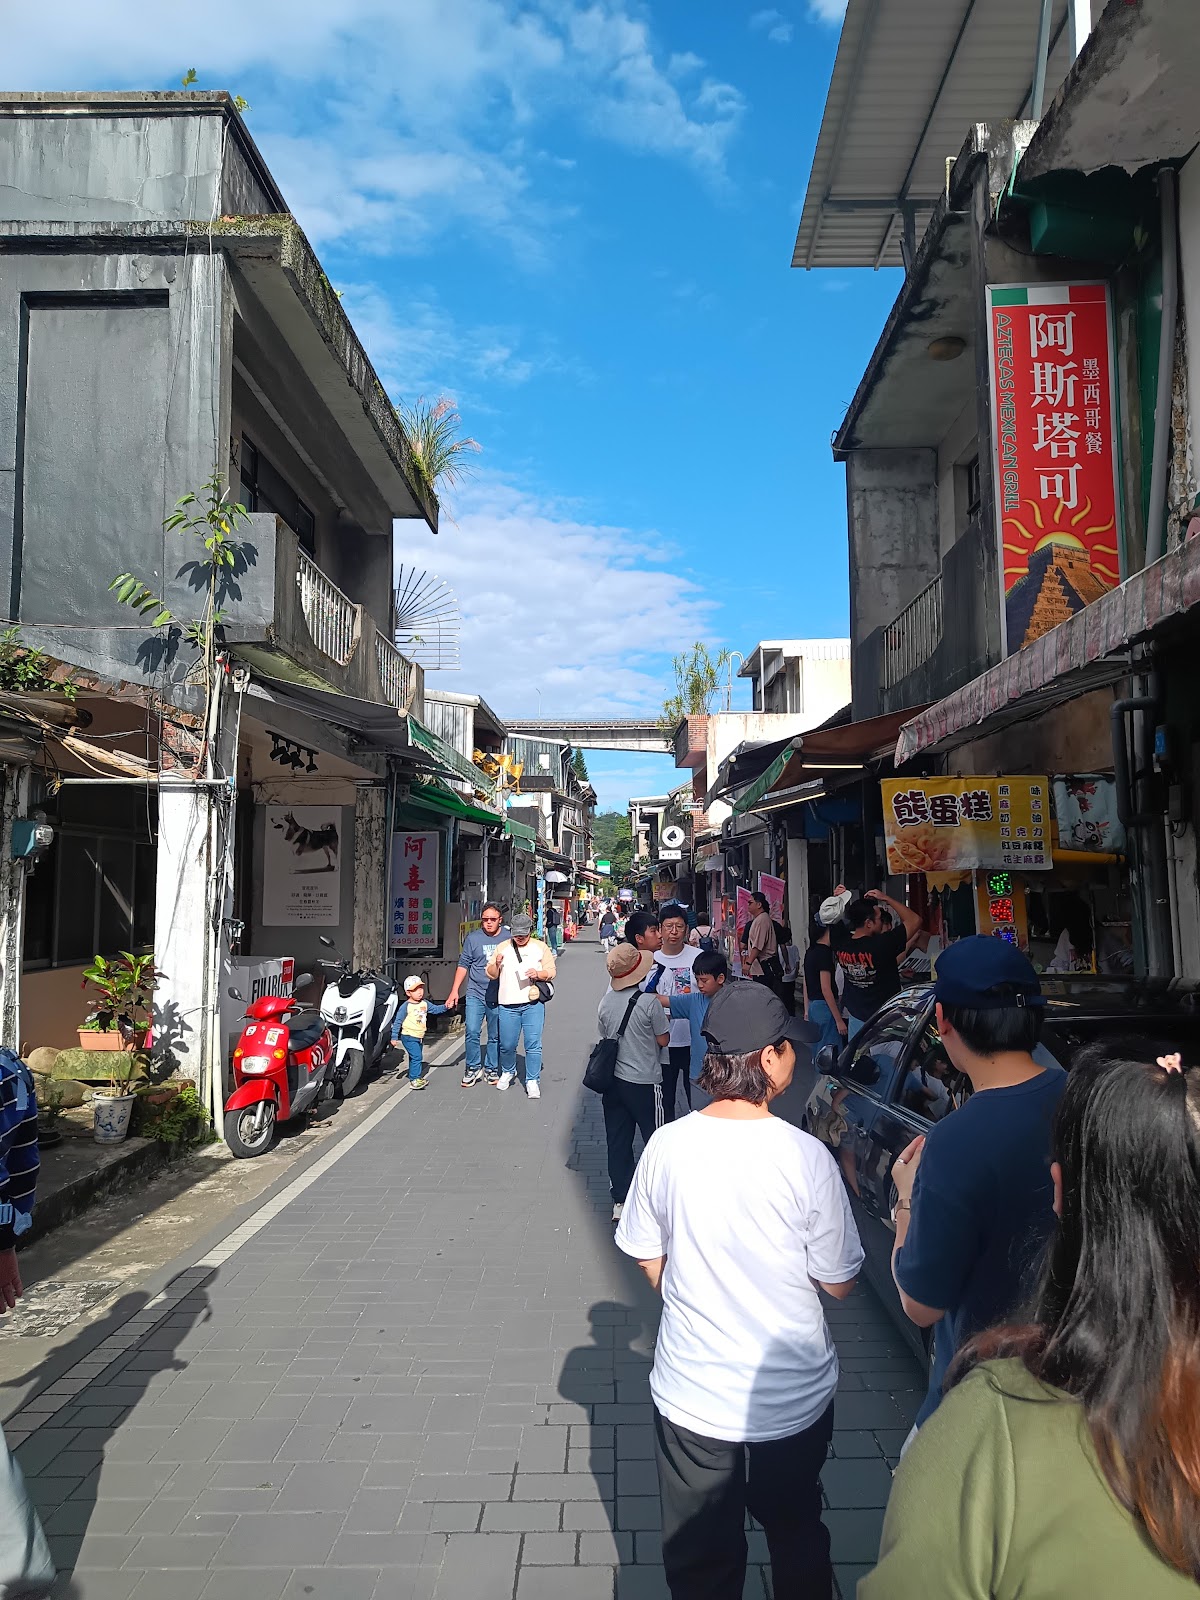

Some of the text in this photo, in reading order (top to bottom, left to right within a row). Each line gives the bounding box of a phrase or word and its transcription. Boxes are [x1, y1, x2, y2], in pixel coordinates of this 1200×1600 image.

[995, 312, 1020, 513] AZTECAS MEXICAN GRILL
[1028, 310, 1083, 510] 阿斯塔可
[1082, 358, 1103, 455] 墨西哥餐
[891, 789, 994, 828] 熊蛋糕
[998, 785, 1042, 797] 原味
[999, 812, 1043, 824] 奶油
[999, 826, 1044, 838] 巧克力
[403, 835, 427, 892] 阿喜
[407, 897, 419, 935] 豬腳飯
[391, 937, 435, 945] 2495-8034
